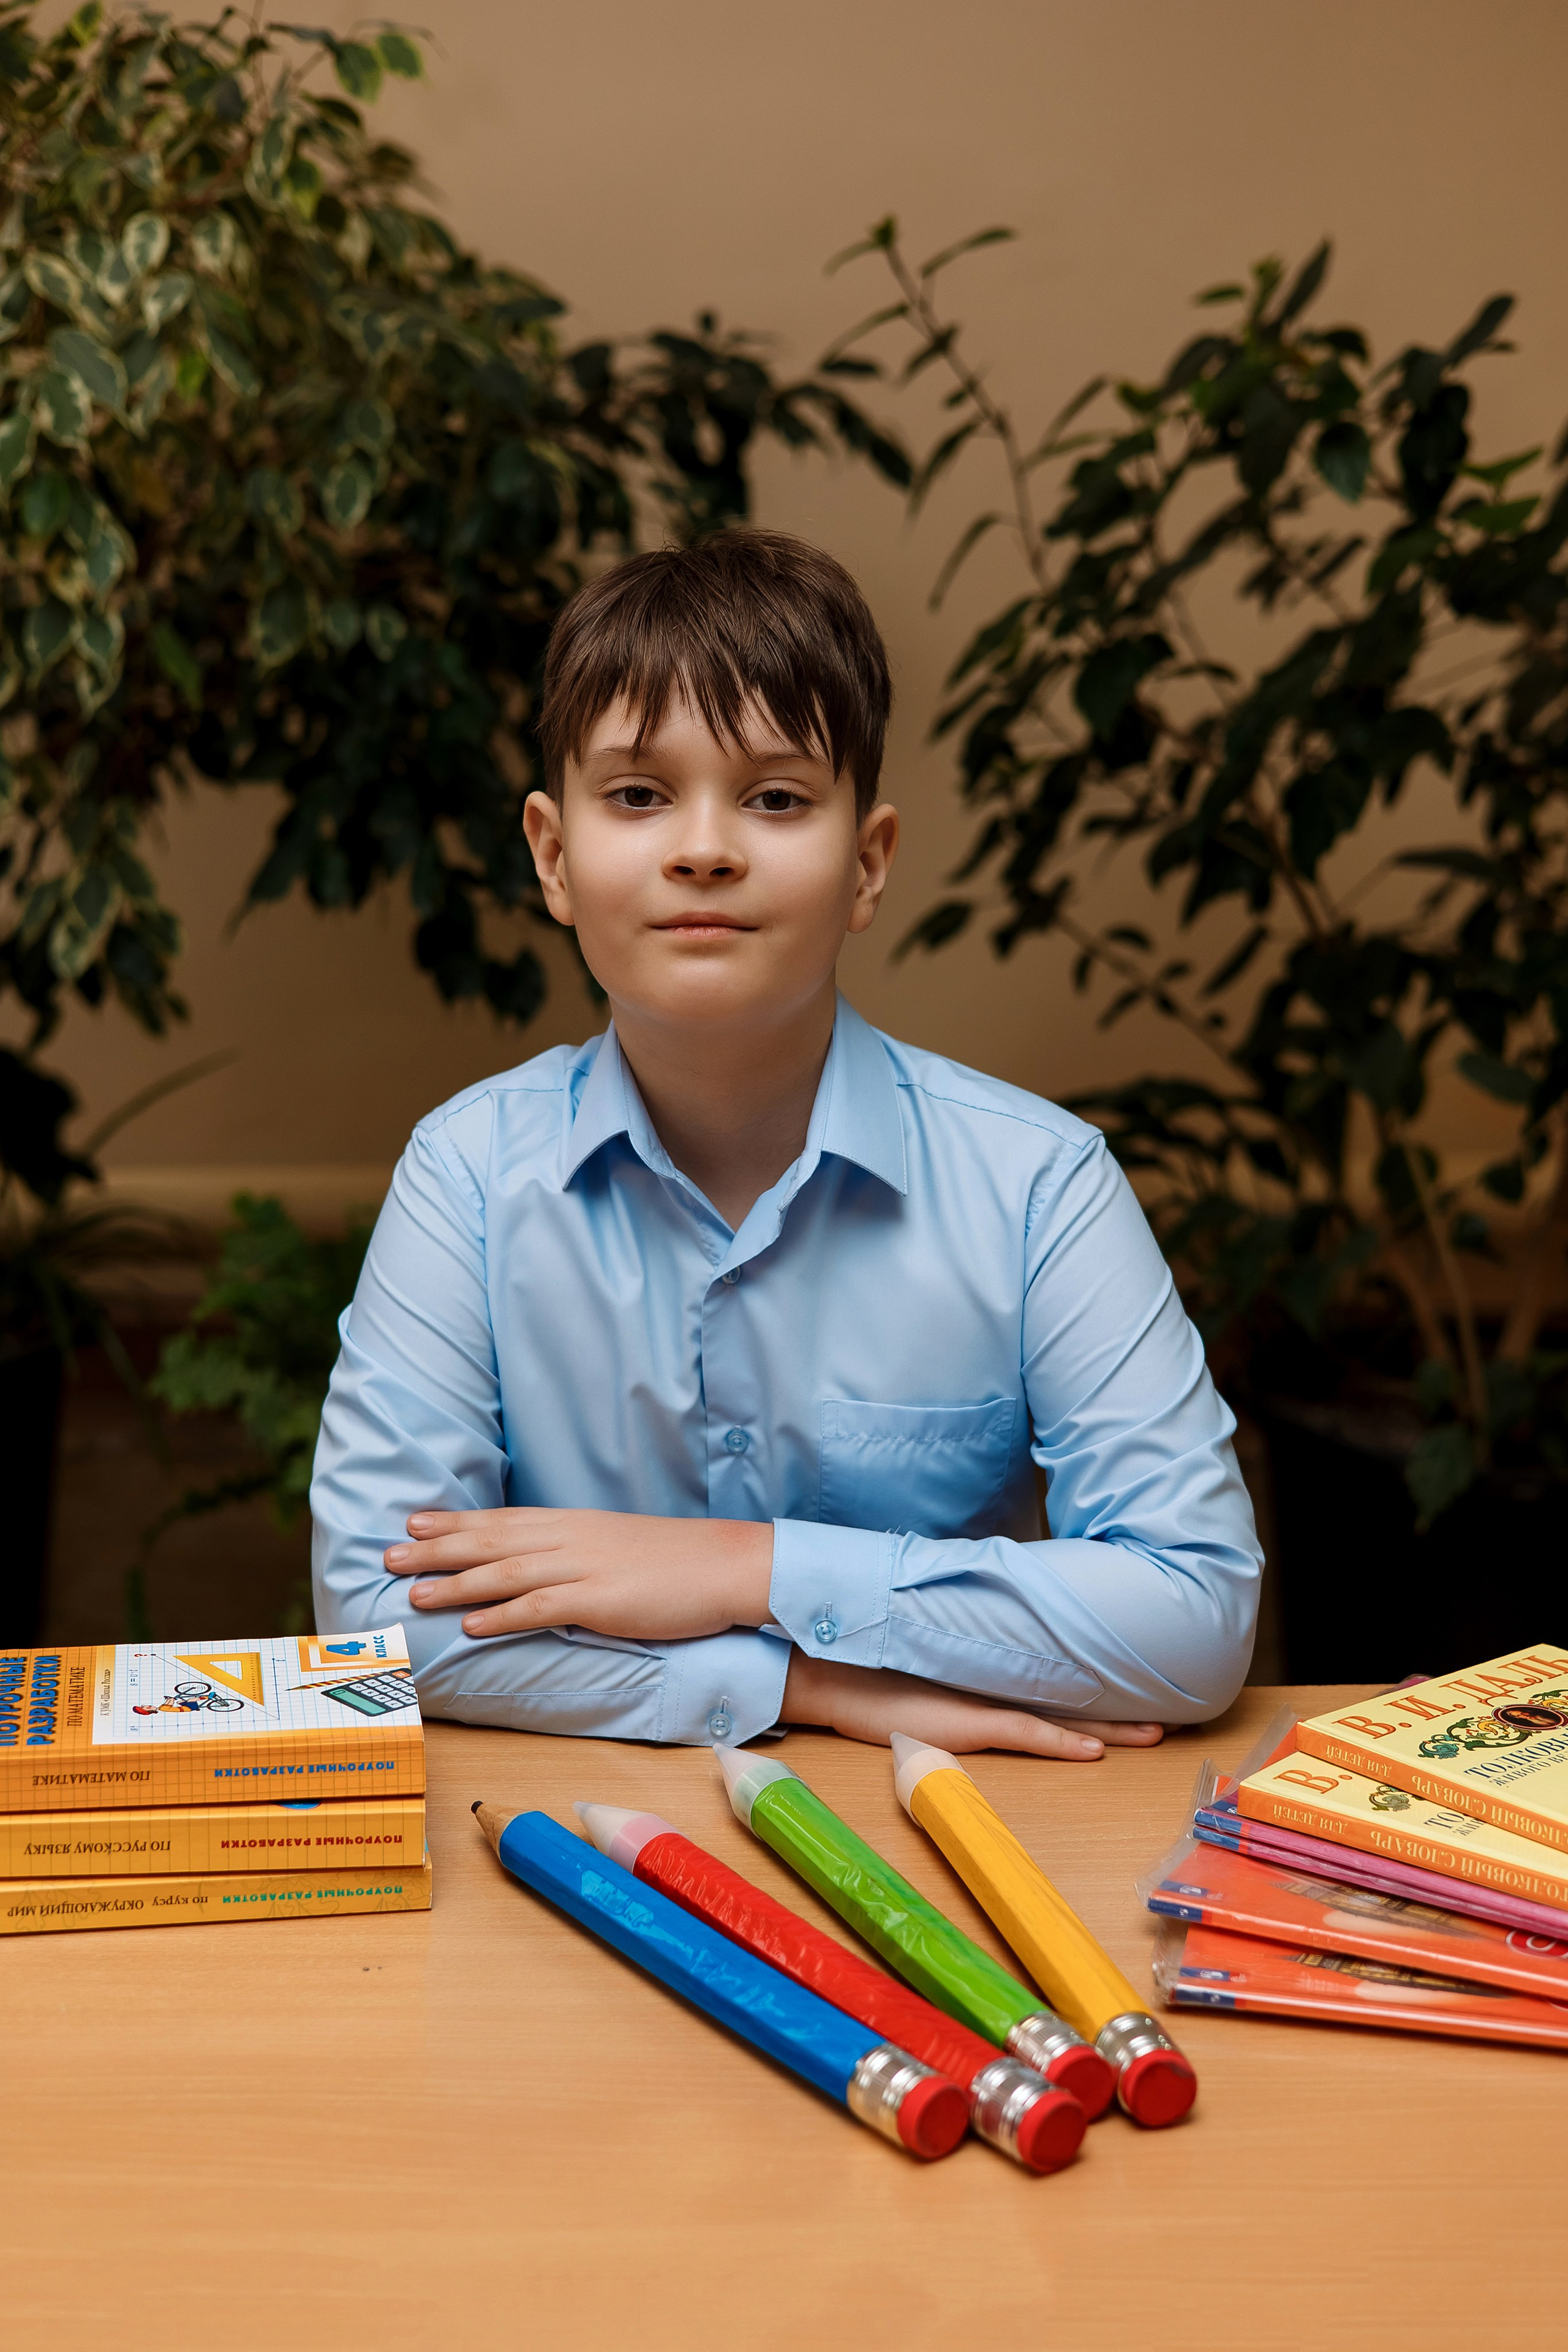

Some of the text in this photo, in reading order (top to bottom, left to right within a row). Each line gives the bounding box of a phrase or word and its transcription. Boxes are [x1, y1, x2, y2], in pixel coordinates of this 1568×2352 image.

[326, 1641, 366, 1656] 4
[373, 1635, 387, 1658] КЛАСС
[0, 1656, 26, 1746] ПОУРОЧНЫЕ
[27, 1656, 61, 1745] РАЗРАБОТКИ
[67, 1667, 85, 1726] ПО МАТЕМАТИКЕ
[1332, 1655, 1568, 1740] В. И. ДАЛЬ
[32, 1771, 150, 1785] ПО МАТЕМАТИКЕ
[215, 1762, 394, 1777] ПОУРОЧНЫЕ РАЗРАБОТКИ
[1488, 1761, 1551, 1786] ЖИВОГО
[1272, 1769, 1353, 1794] В.
[1326, 1745, 1568, 1845] ЛКОВЫЙ СЛОВАРЬ ДЛЯ ДЕТЕЙ
[1273, 1804, 1317, 1826] ДЕТЕЙ
[1319, 1817, 1348, 1835] ДЛЯ
[23, 1840, 171, 1855] ПО РУССКОМУ ЯЗЫКУ
[222, 1835, 402, 1849] ПОУРОЧНЫЕ РАЗРАБОТКИ
[1370, 1831, 1455, 1868] СЛОВАРЬ
[152, 1895, 189, 1906] курсу
[222, 1886, 402, 1903] ПОУРОЧНЫЕ РАЗРАБОТКИ
[7, 1905, 36, 1917] МИР
[40, 1899, 144, 1916] ОКРУЖАЮЩИЙ
